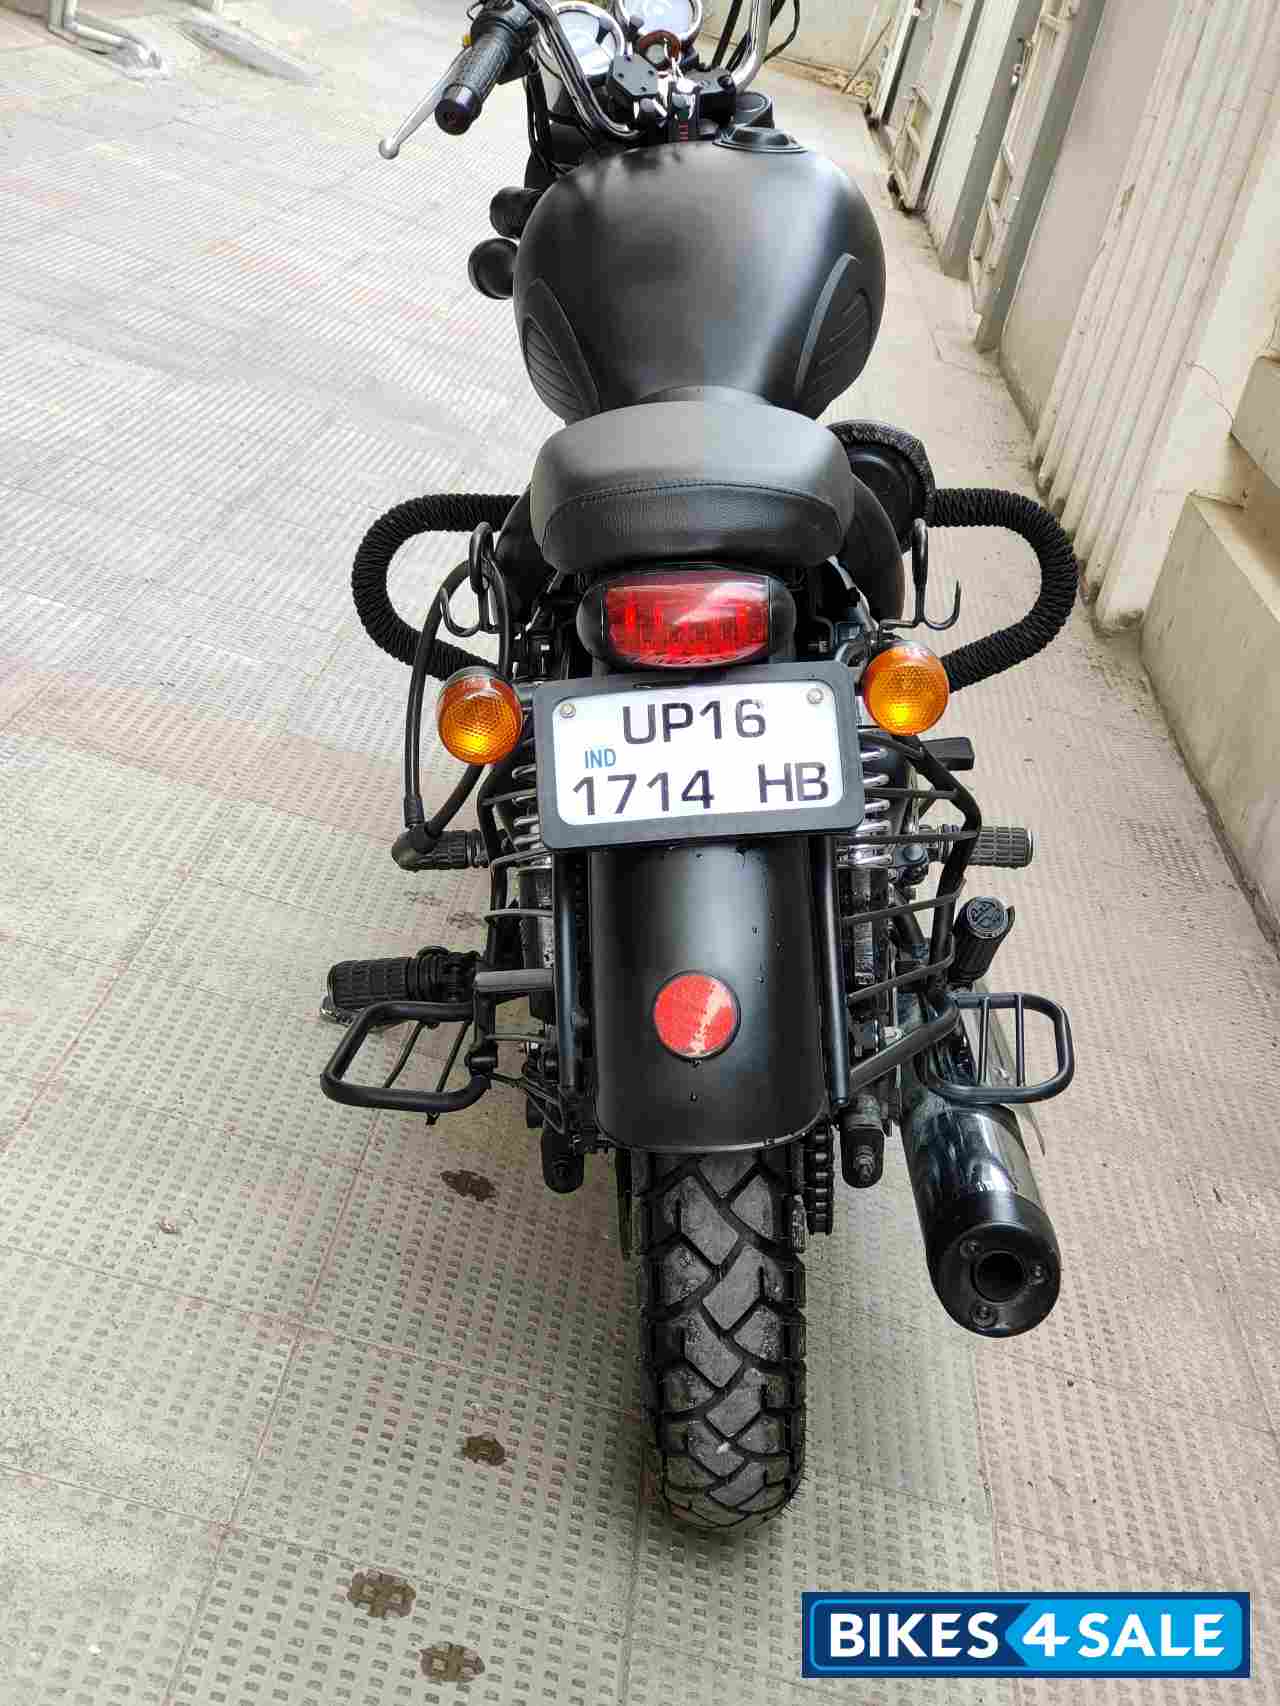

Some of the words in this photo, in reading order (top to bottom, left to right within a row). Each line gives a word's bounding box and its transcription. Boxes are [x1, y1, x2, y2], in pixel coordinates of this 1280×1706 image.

[622, 699, 767, 745] UP16
[584, 748, 617, 768] IND
[572, 769, 715, 816] 1714
[757, 762, 829, 803] HB
